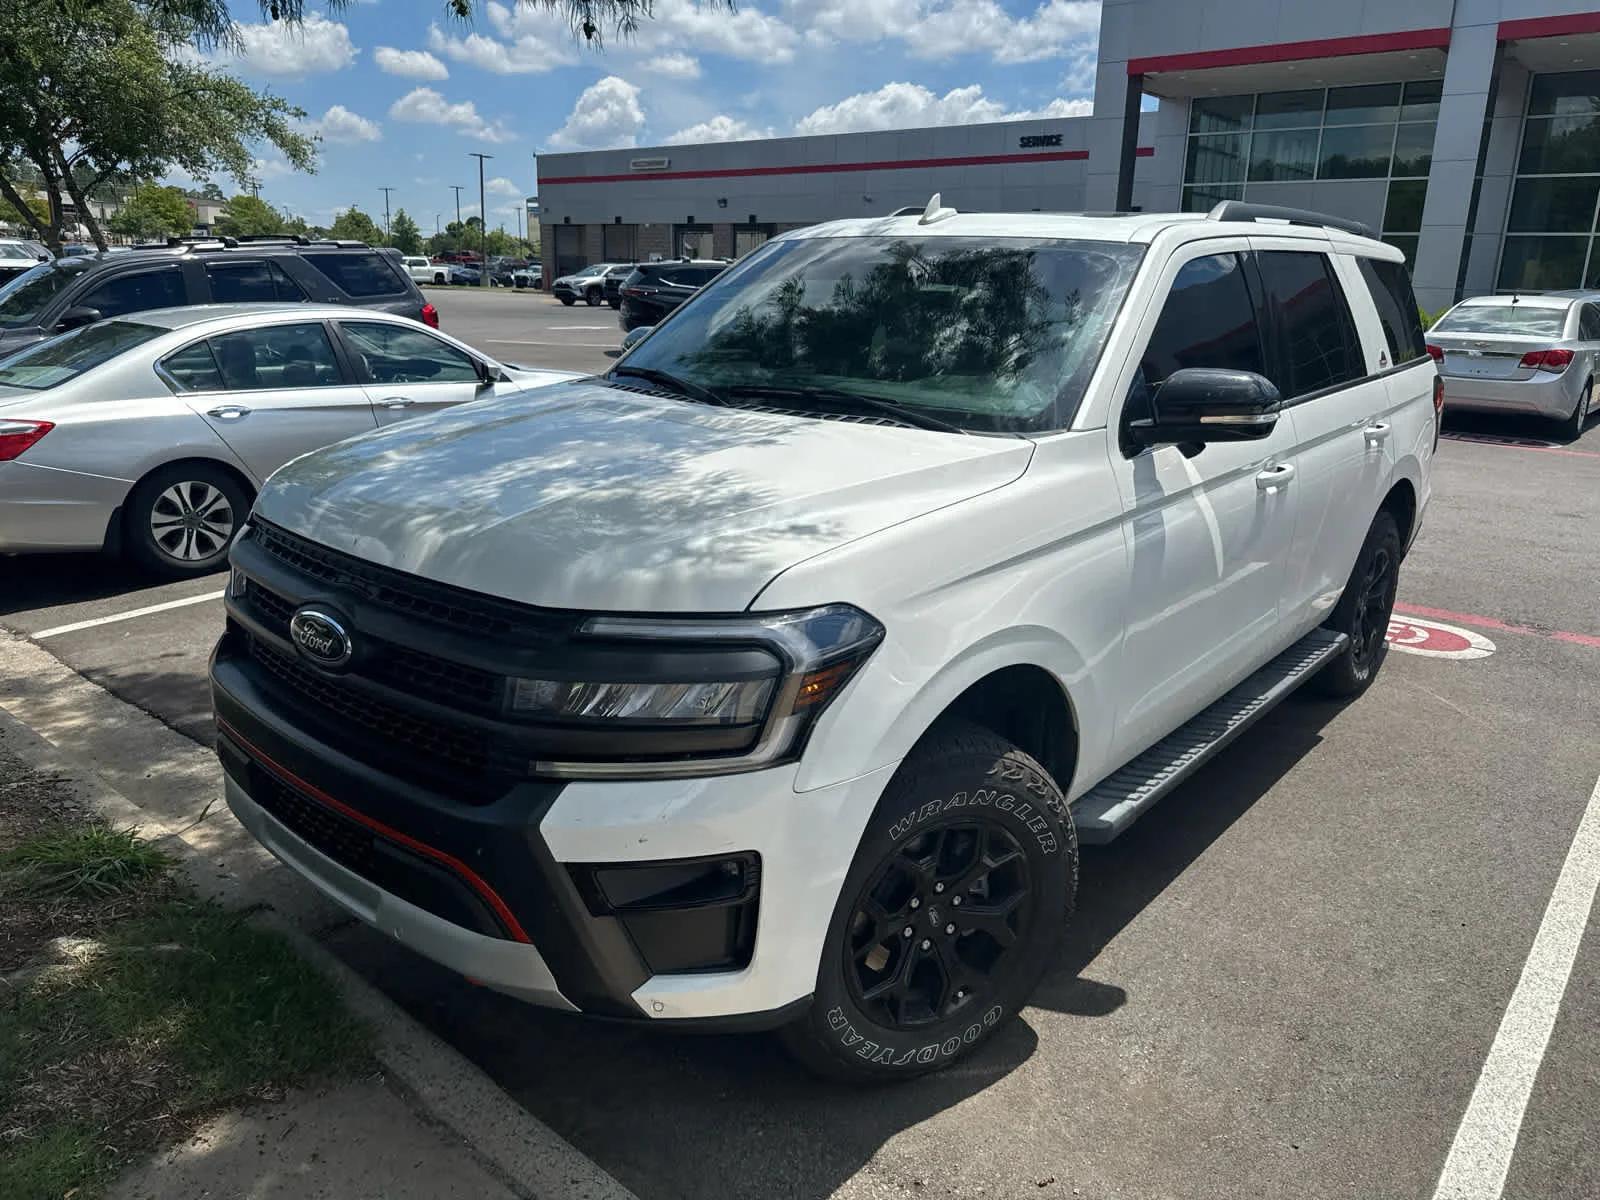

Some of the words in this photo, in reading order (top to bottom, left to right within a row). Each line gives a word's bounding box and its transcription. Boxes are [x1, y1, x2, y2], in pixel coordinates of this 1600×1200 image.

[1019, 134, 1064, 148] SERVICE
[300, 620, 333, 655] Ford
[888, 789, 1057, 854] WRANGLER
[826, 1005, 1002, 1066] GOODYEAR
